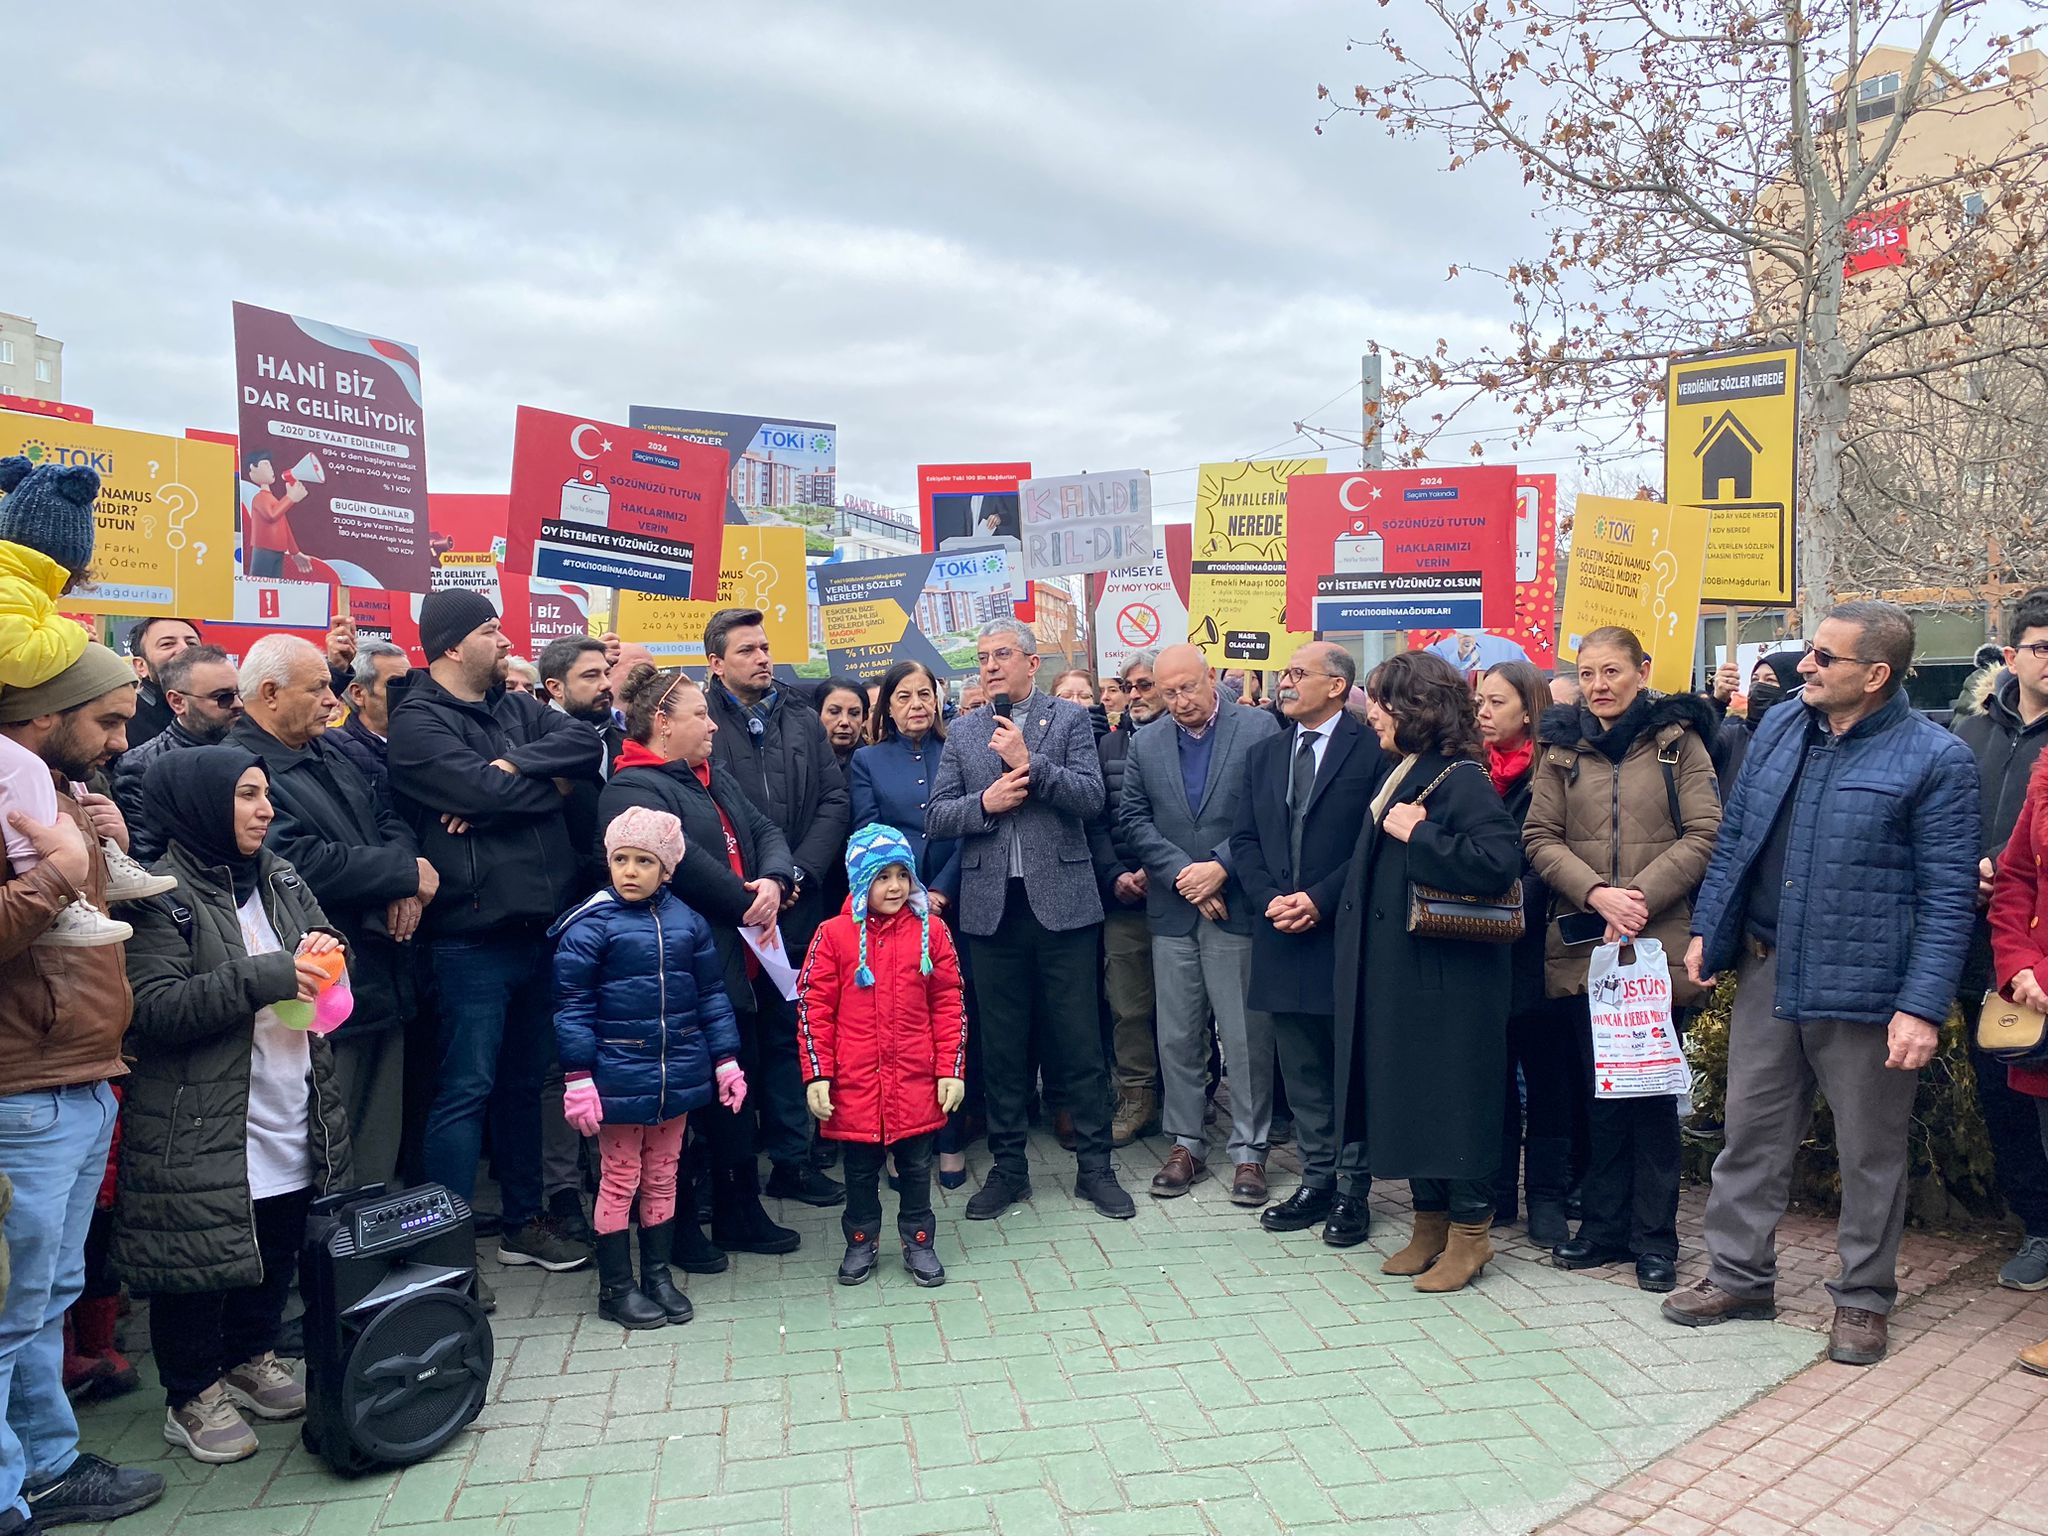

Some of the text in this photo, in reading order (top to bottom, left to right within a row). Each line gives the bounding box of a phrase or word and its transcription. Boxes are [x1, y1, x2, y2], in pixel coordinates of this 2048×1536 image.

[257, 353, 376, 401] HANİ BİZ
[1678, 371, 1784, 396] VERDİĞİNİZ SÖZLER NEREDE
[244, 386, 417, 436] DAR GELİRLİYDİK
[308, 428, 321, 439] DE
[323, 431, 348, 444] VAAT
[351, 437, 397, 453] EDİLENLER
[648, 441, 668, 452] 2024
[634, 452, 654, 462] Seçim
[397, 460, 417, 471] taksit
[346, 464, 365, 475] Oran
[366, 468, 381, 477] 240
[381, 470, 392, 480] Ay
[392, 472, 411, 482] Vade
[1420, 477, 1443, 486] 2024
[101, 487, 152, 503] NAMUS
[395, 484, 412, 494] KDV
[669, 487, 701, 501] TUTUN
[1406, 491, 1428, 499] Seçim
[335, 501, 410, 520] BUGÜN OLANLAR
[621, 502, 687, 522] HAKLARIMIZI
[1228, 514, 1283, 537] NEREDE
[1447, 517, 1486, 527] TUTUN
[372, 523, 394, 532] Varan
[394, 525, 414, 534] Taksit
[397, 537, 414, 545] Vade
[541, 525, 693, 559] OY İSTEMEYE YÜZÜNÜZ OLSUN
[104, 543, 140, 554] Farkı
[1396, 542, 1471, 553] HAKLARIMIZI
[109, 557, 158, 570] Ödeme
[443, 553, 492, 563] DUYUN BİZİ
[1416, 556, 1450, 568] VERİN
[1604, 550, 1624, 566] SÖZÜ
[1624, 556, 1651, 572] NAMUS
[444, 569, 486, 578] GELİRLİYE
[1580, 560, 1598, 575] SÖZÜ
[824, 583, 865, 594] VERİLEN
[866, 579, 903, 590] SÖZLER
[1107, 582, 1171, 593] OY MOY YOK!!!
[1239, 579, 1263, 589] Maaşı
[1317, 577, 1481, 591] OY İSTEMEYE YÜZÜNÜZ OLSUN
[826, 591, 869, 603] NEREDE?
[1615, 584, 1639, 599] TUTUN
[537, 603, 561, 618] BİZ
[680, 611, 706, 619] Vade
[642, 622, 705, 631] 240 Ay Sabi
[1228, 641, 1255, 649] OLACAK
[845, 648, 857, 659] %
[868, 644, 893, 656] KDV
[859, 661, 870, 669] AY
